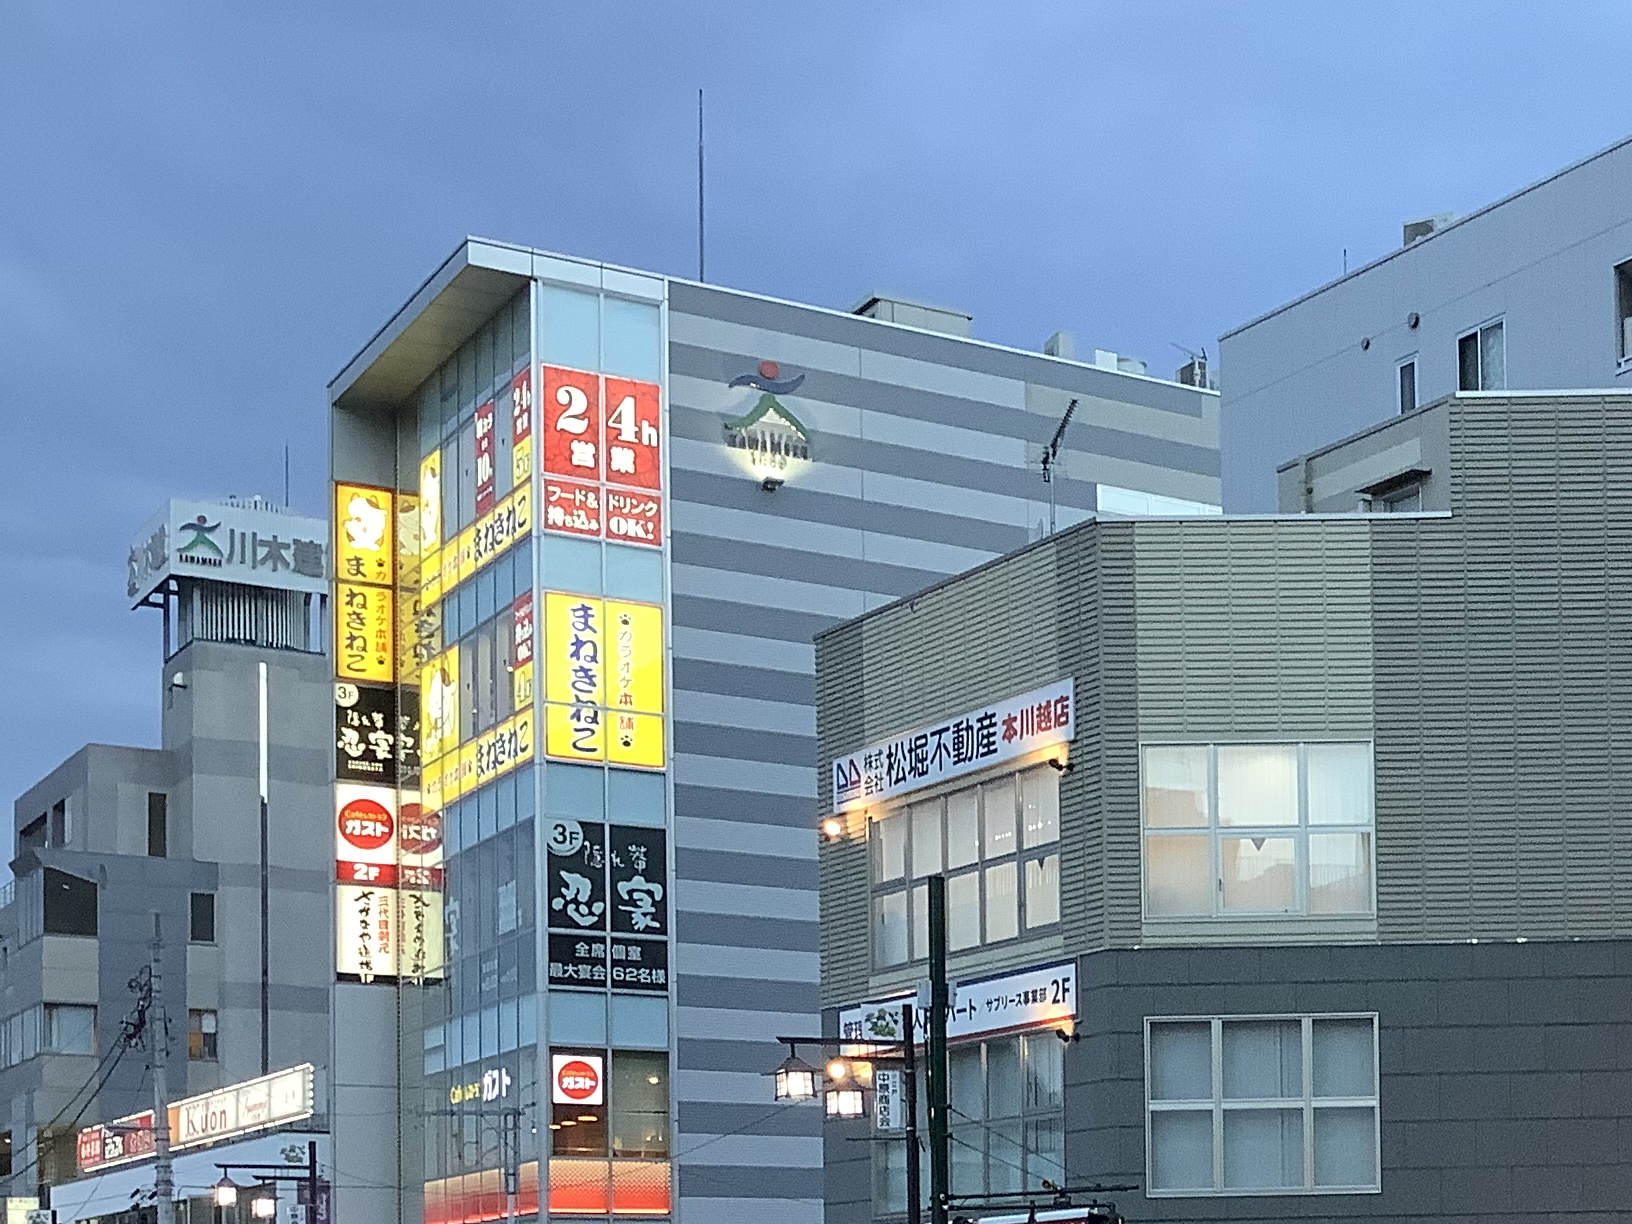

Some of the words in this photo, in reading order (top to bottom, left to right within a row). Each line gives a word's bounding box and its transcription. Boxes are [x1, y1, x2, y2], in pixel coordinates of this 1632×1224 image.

[570, 439, 635, 474] 営業
[609, 517, 654, 540] OK!
[345, 555, 368, 672] まねきねこ
[337, 686, 355, 699] 3F
[569, 603, 599, 753] まねきねこ
[619, 631, 634, 731] カラオケ本舗
[1002, 694, 1070, 744] 本川越店
[476, 720, 529, 777] まねきねこ
[886, 711, 998, 788] 松堀不動産
[345, 819, 390, 837] ガスト
[553, 824, 580, 845] 3F
[353, 863, 380, 880] 2F
[551, 870, 663, 931] 忍家
[549, 962, 666, 984] 最大宴会62名様
[986, 986, 1048, 1013] サブリース事業部
[1051, 976, 1071, 1005] 2F
[561, 1076, 596, 1090] ガスト
